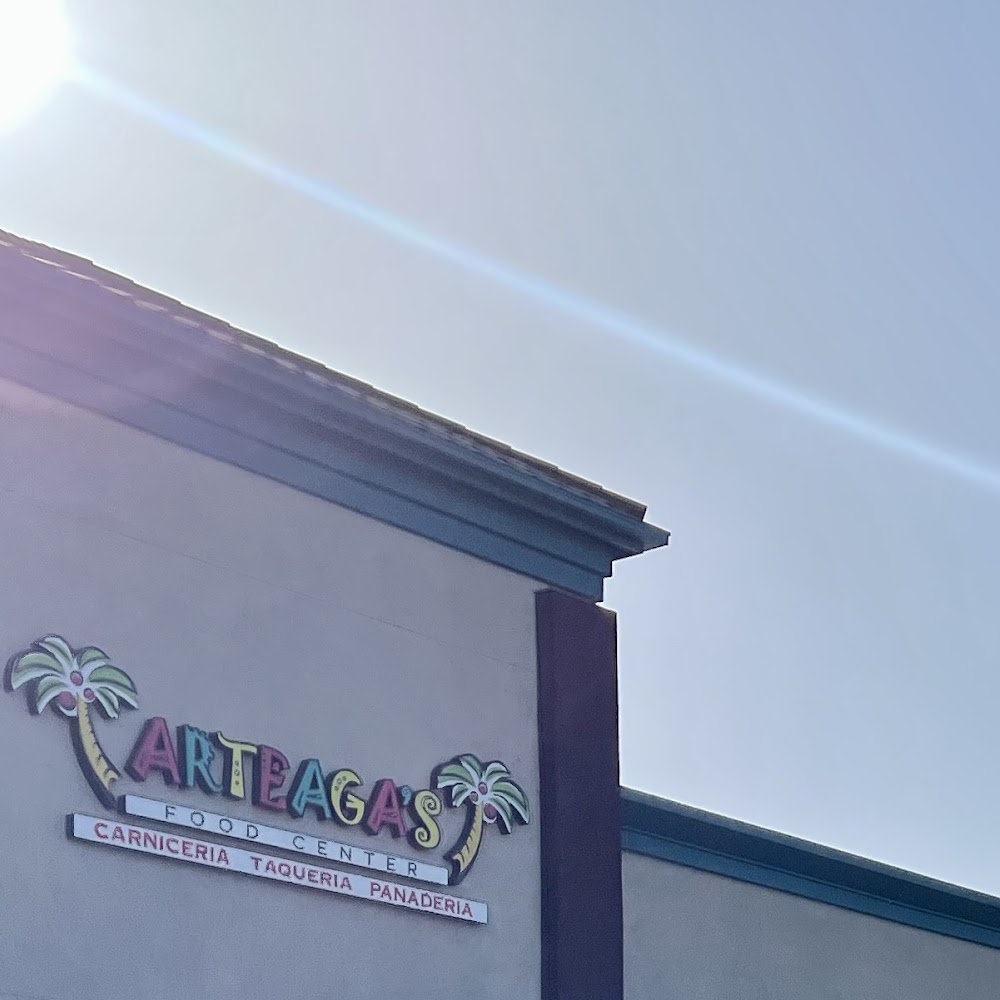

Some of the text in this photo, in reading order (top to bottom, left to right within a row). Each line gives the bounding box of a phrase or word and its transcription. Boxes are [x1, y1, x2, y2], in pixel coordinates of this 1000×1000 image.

[126, 716, 444, 849] ARTEAGA'S
[93, 821, 474, 919] CARNICERIA TAQUERIA PANADERIA
[164, 805, 418, 877] FOOD CENTER
